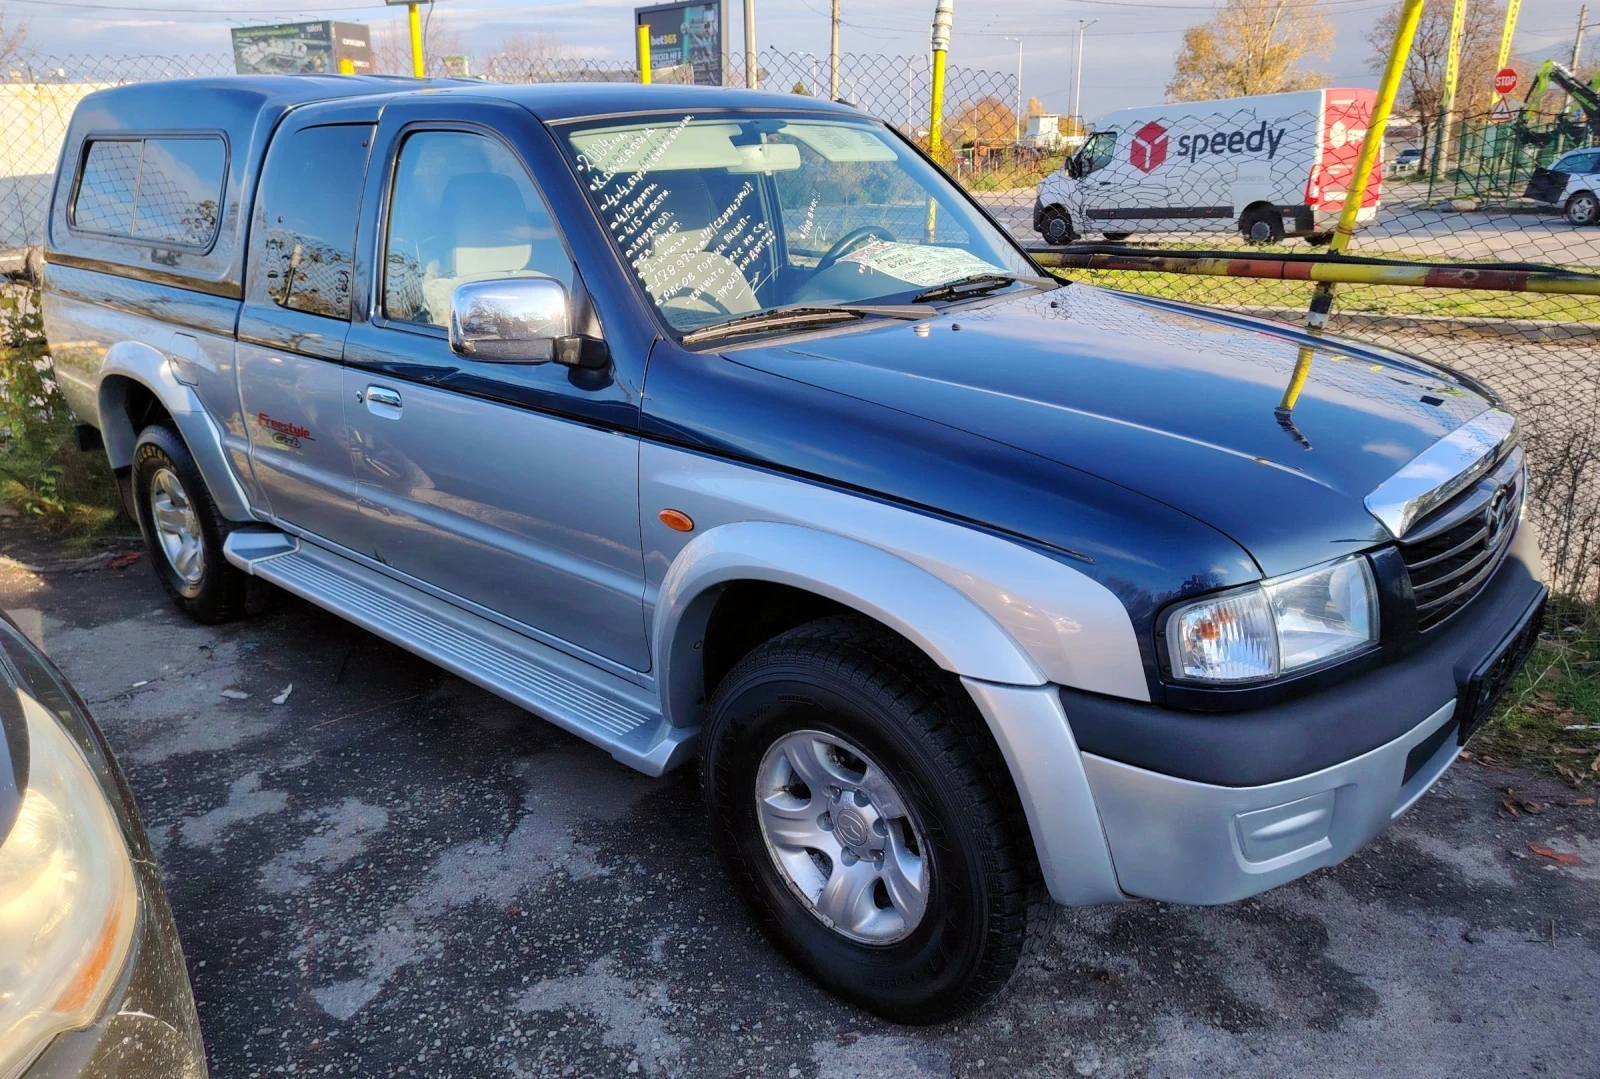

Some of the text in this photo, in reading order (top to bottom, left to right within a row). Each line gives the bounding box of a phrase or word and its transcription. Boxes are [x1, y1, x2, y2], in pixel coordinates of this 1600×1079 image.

[650, 34, 677, 46] bet365
[1495, 76, 1517, 87] STOP
[1178, 121, 1285, 163] speedy
[258, 412, 311, 439] Freestyle
[271, 432, 302, 449] Cab
